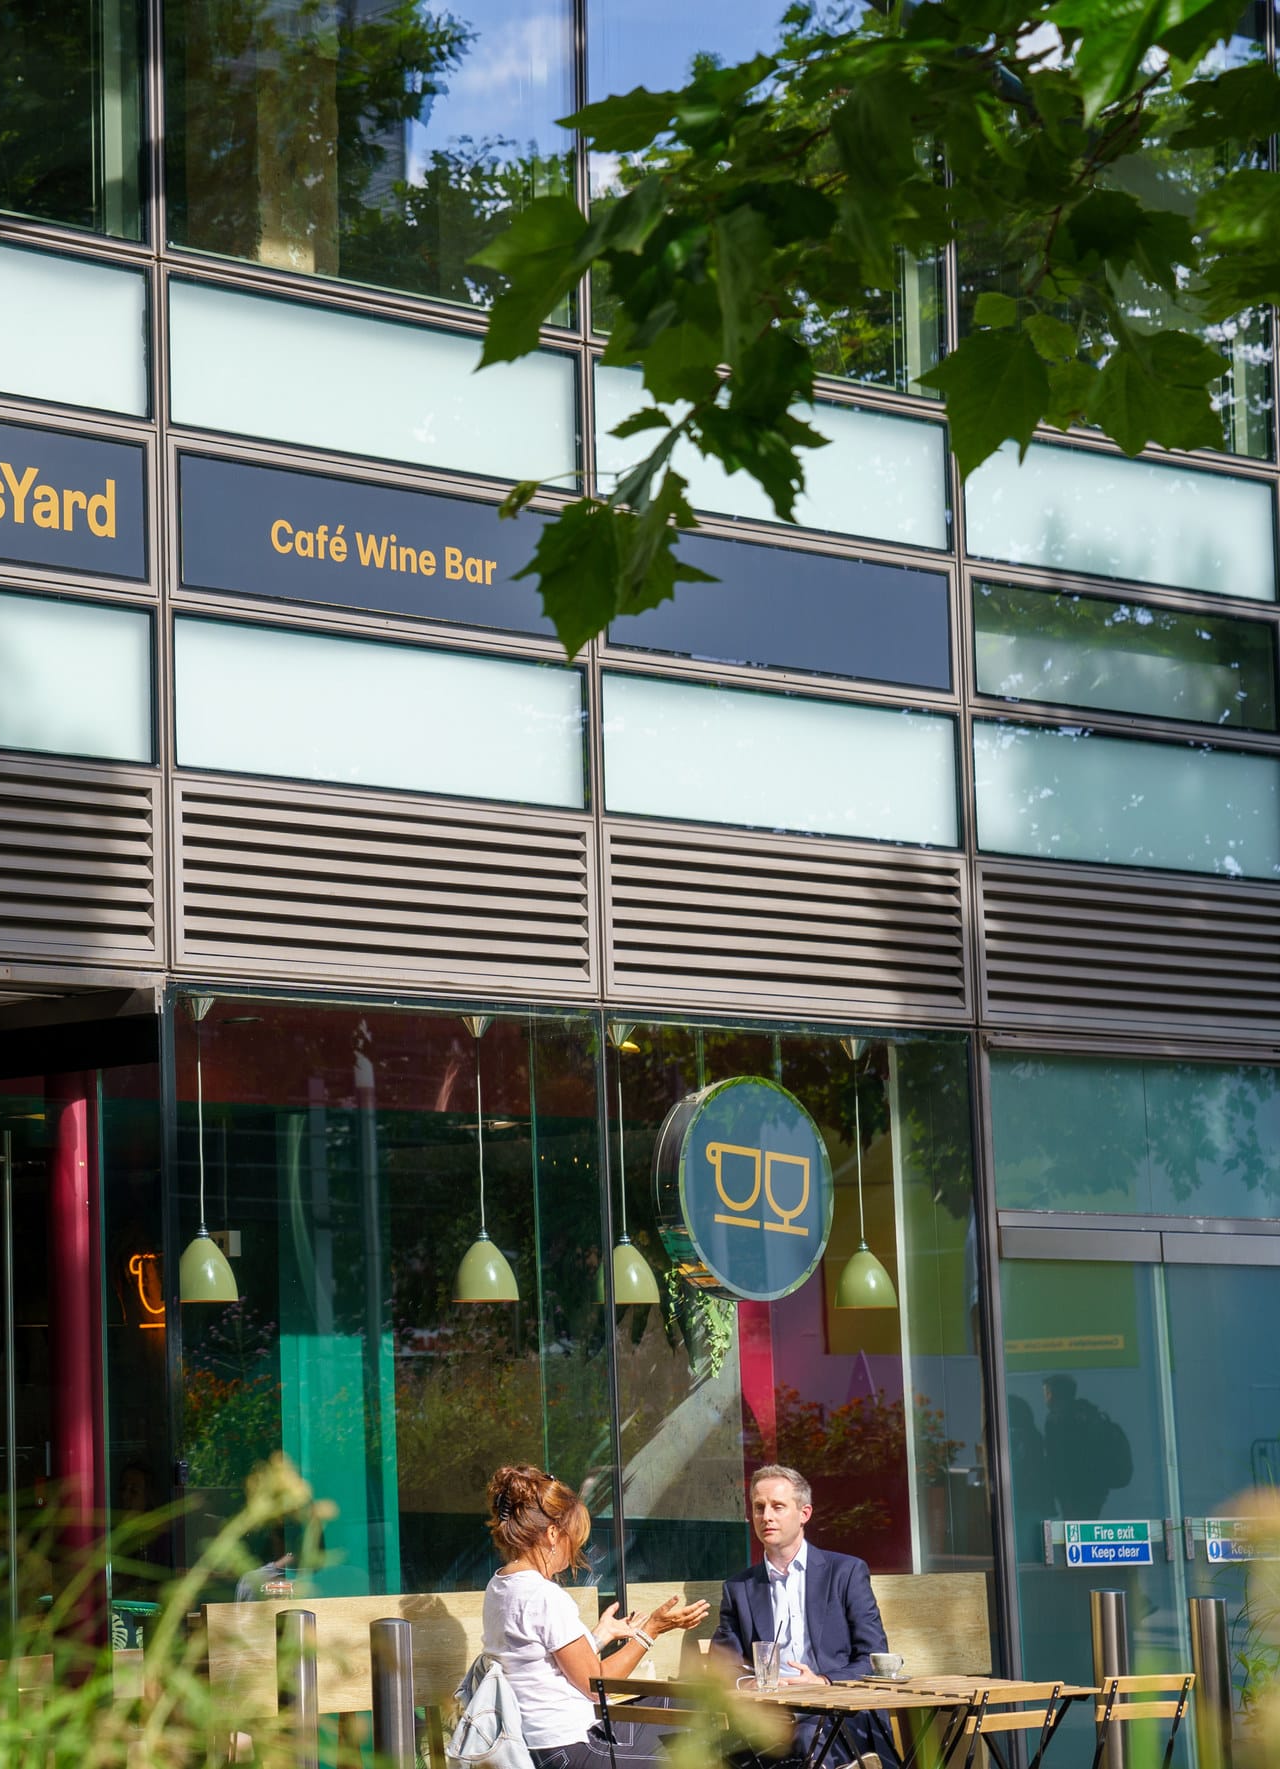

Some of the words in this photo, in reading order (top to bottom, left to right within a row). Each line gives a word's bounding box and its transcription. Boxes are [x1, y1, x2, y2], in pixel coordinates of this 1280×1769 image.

[270, 519, 348, 563] Café
[355, 531, 437, 576] Wine
[445, 546, 497, 586] Bar
[1093, 1526, 1114, 1540] Fire
[1117, 1525, 1136, 1539] exit
[1091, 1547, 1116, 1561] Keep
[1117, 1545, 1140, 1559] clear
